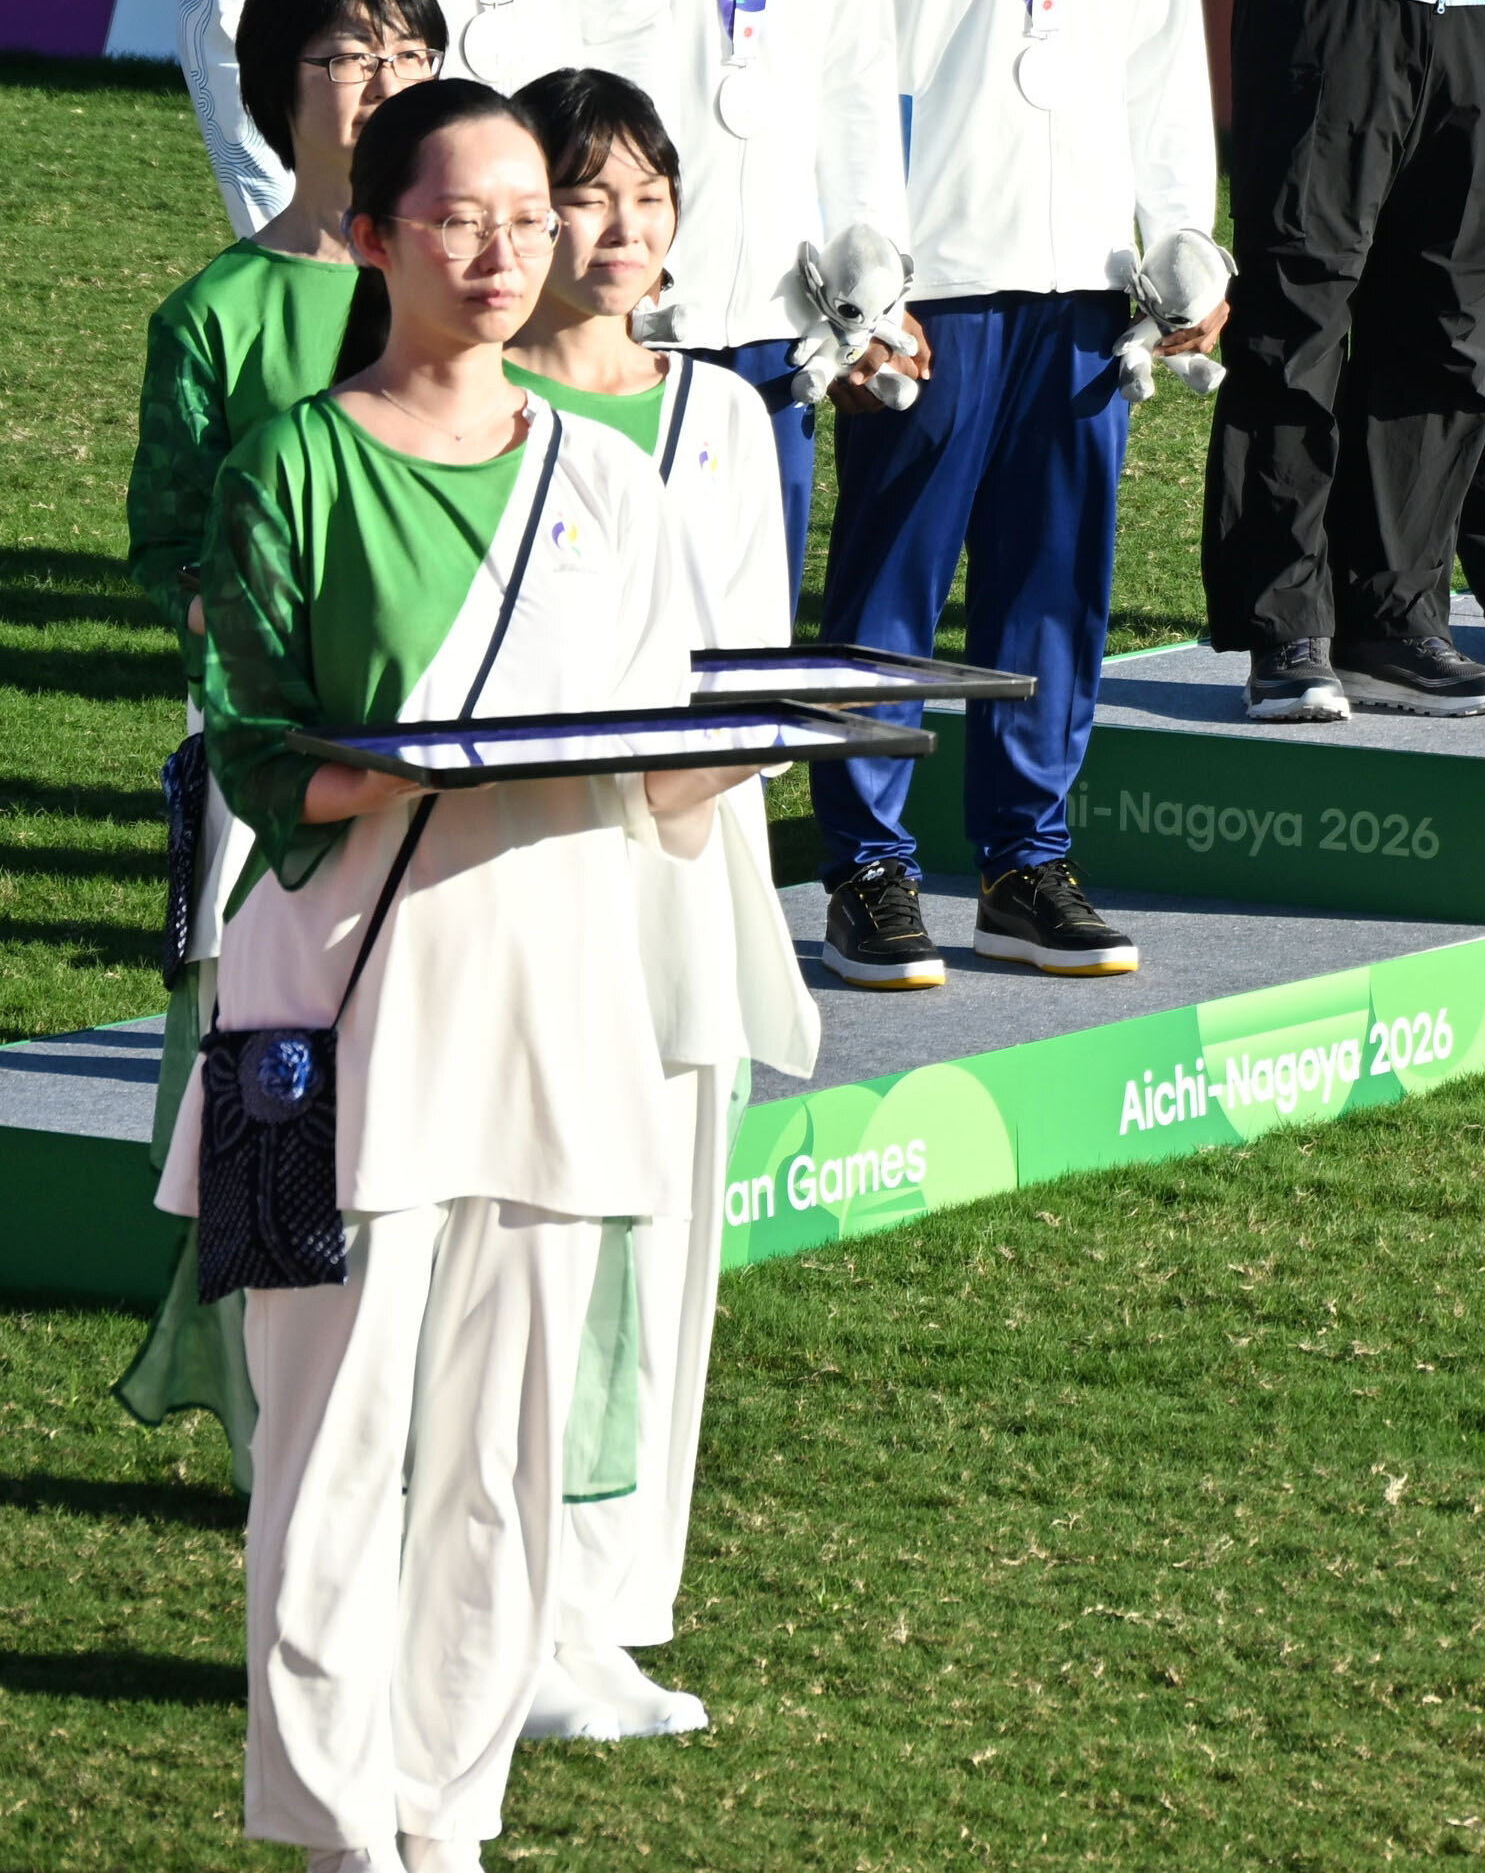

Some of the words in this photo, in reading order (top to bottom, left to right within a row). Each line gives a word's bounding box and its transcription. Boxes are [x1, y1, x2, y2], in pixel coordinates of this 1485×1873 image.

[1319, 807, 1440, 860] 2026
[1119, 1037, 1362, 1136] Aichi-Nagoya
[1367, 1006, 1454, 1080] 2026
[788, 1138, 927, 1212] Games
